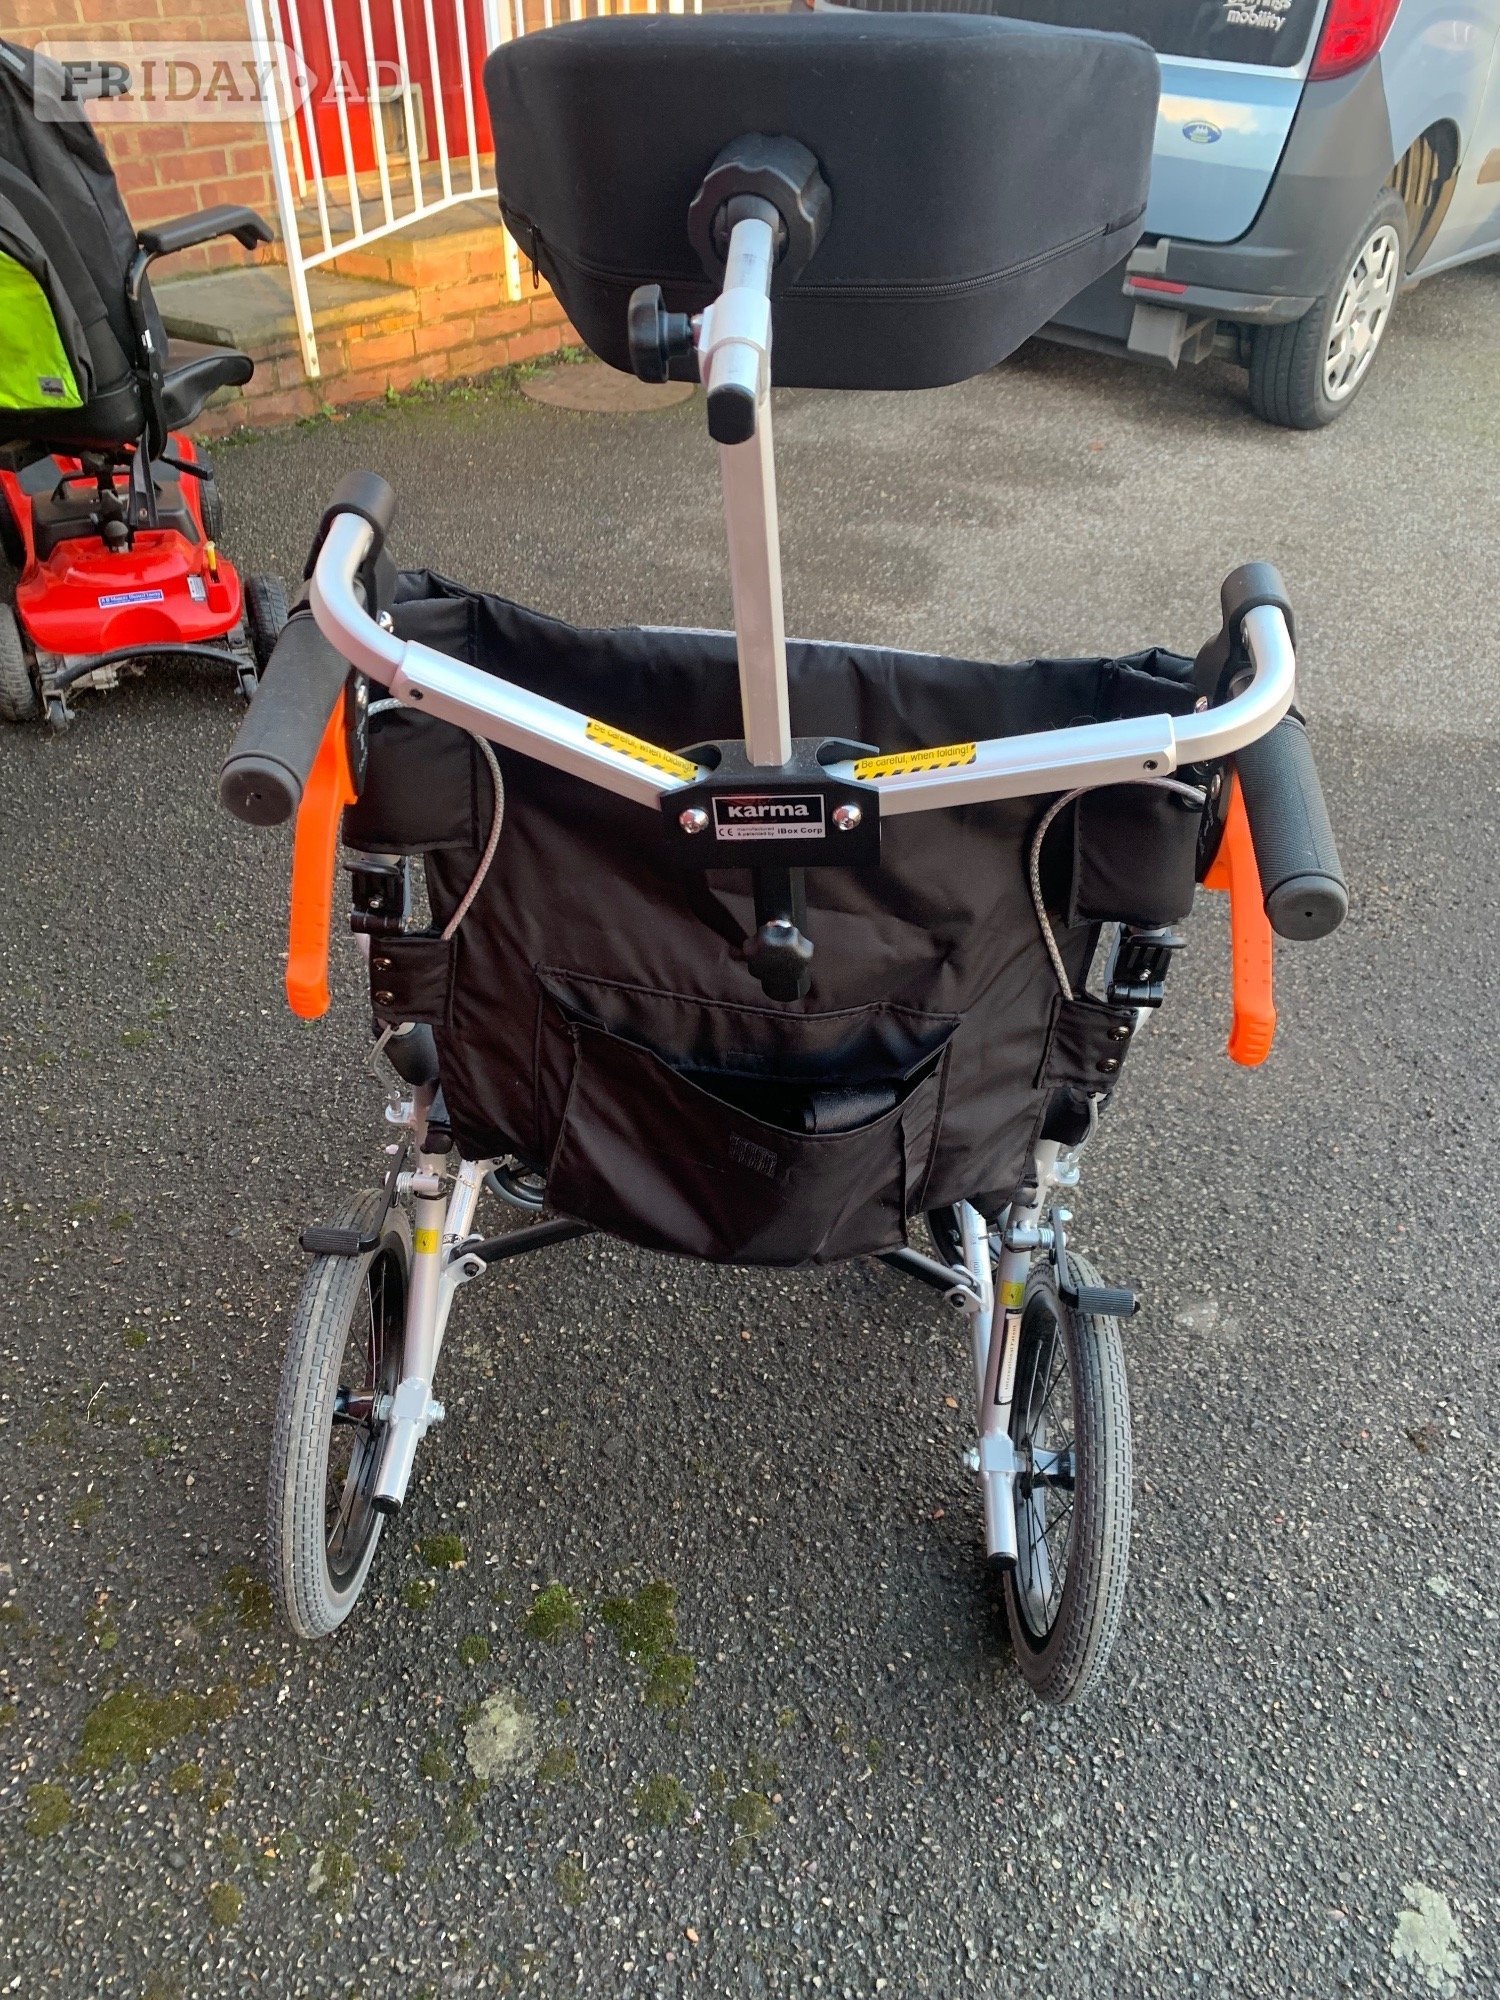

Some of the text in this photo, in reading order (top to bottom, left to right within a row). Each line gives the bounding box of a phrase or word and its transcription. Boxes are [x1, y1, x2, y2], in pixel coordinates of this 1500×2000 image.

[1226, 9, 1286, 32] mobility
[594, 723, 605, 734] Be
[640, 742, 662, 759] when
[663, 750, 693, 773] folding!
[861, 745, 969, 769] Be careful, when folding!
[728, 804, 809, 818] karma
[777, 827, 823, 835] iBox Corp
